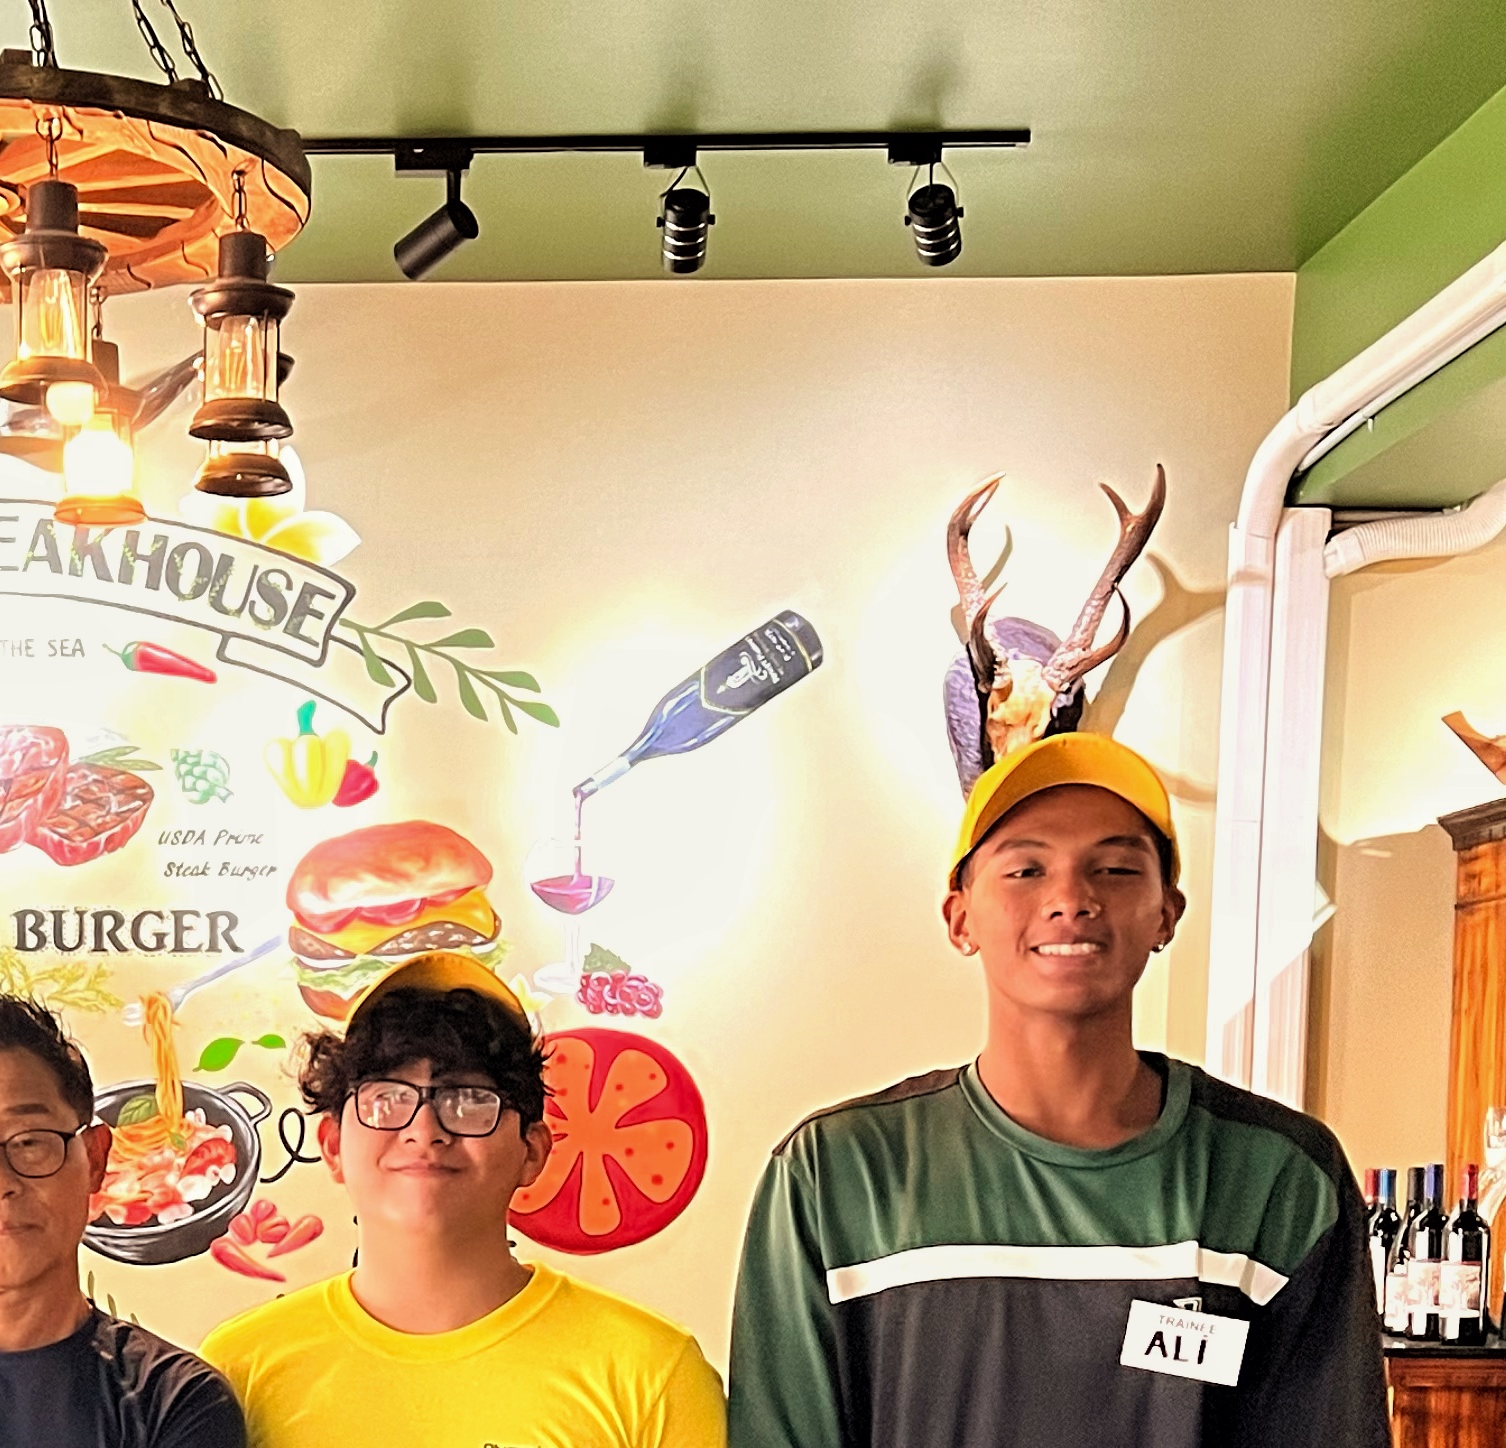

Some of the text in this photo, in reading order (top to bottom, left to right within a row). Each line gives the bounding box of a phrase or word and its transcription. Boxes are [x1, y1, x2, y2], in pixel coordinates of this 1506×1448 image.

[48, 638, 86, 658] SEA
[158, 829, 206, 845] USDA
[163, 861, 278, 881] Steak Burger
[11, 907, 245, 956] BURGER
[1159, 1315, 1217, 1335] TRAINEE
